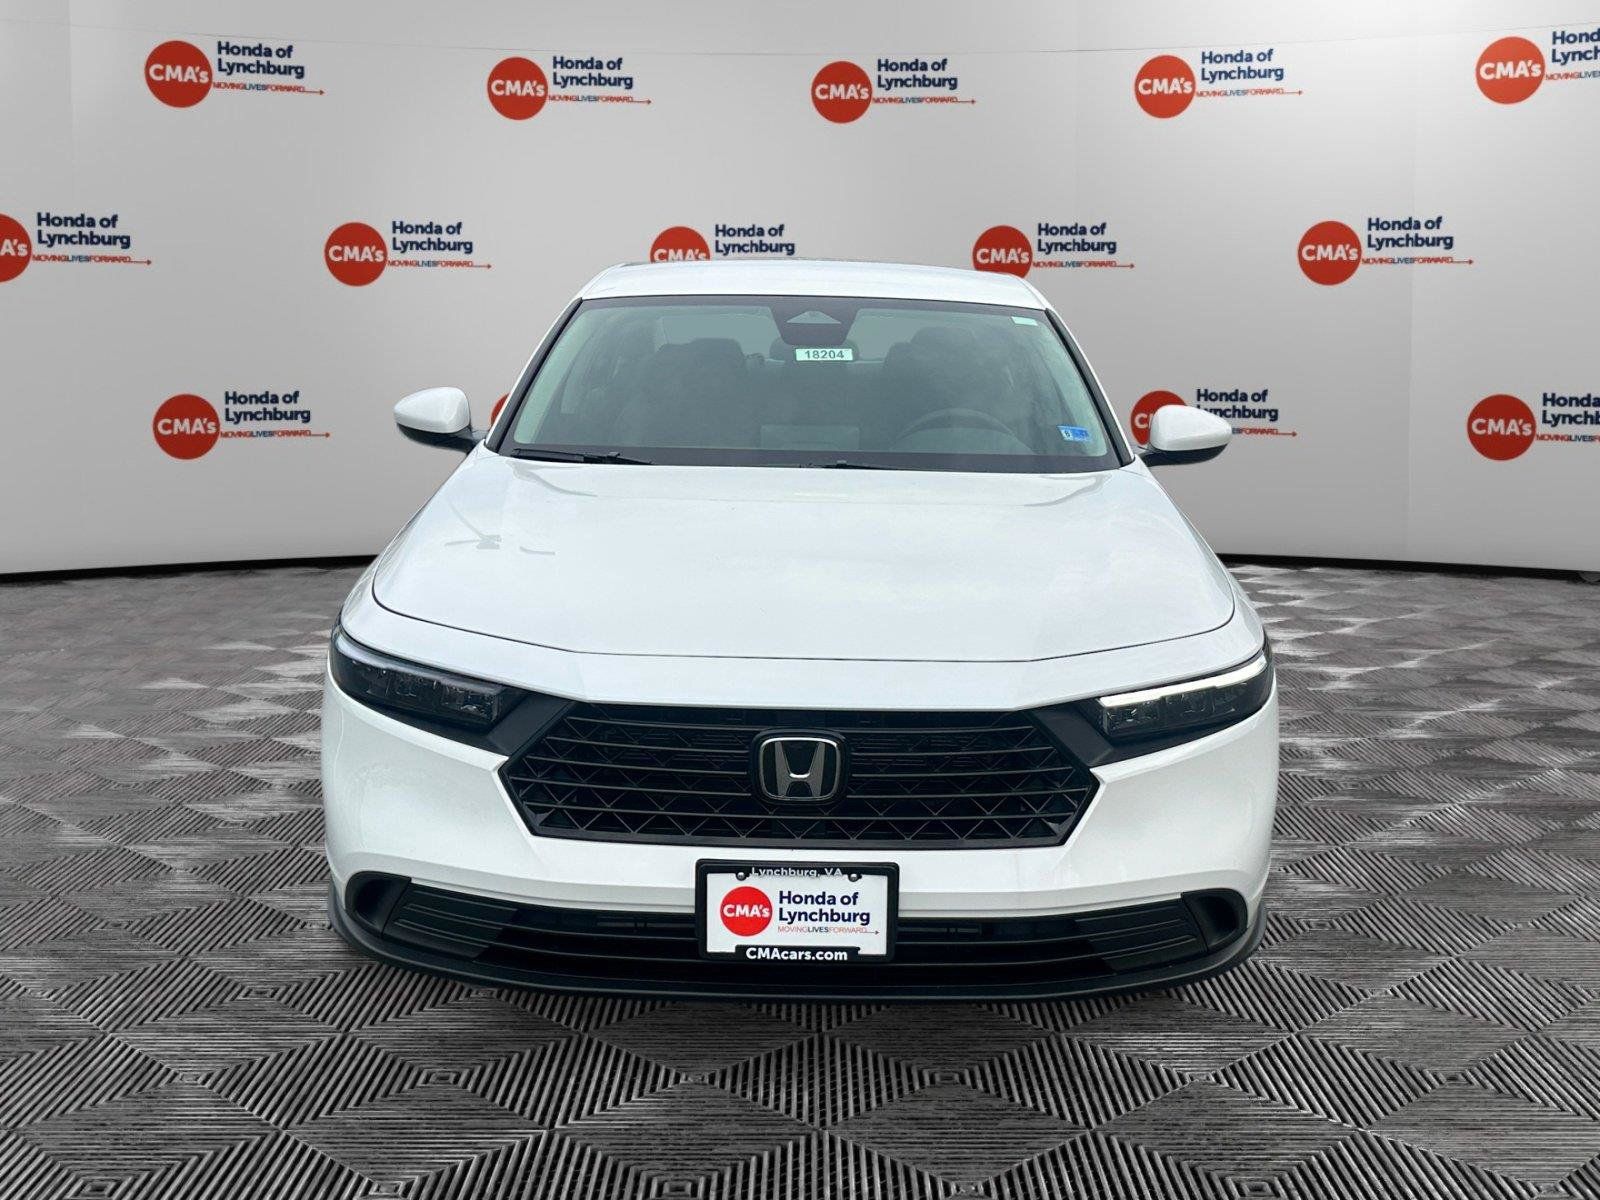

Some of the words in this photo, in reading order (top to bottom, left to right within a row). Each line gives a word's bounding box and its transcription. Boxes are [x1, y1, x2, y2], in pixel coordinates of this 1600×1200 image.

[217, 41, 272, 58] Honda
[275, 44, 294, 58] of
[1201, 51, 1253, 66] Honda
[1256, 49, 1274, 64] of
[217, 57, 305, 79] Lynchburg
[552, 56, 603, 70] Honda
[604, 57, 623, 71] of
[877, 58, 928, 72] Honda
[930, 59, 948, 72] of
[1479, 60, 1542, 81] CMA's
[148, 63, 210, 83] CMA's
[552, 72, 634, 89] Lynchburg
[1201, 67, 1285, 84] Lynchburg
[491, 80, 546, 98] CMA's
[815, 83, 869, 100] CMA's
[877, 75, 958, 91] Lynchburg
[1138, 79, 1193, 96] CMA's
[37, 212, 94, 228] Honda
[99, 214, 118, 229] of
[391, 221, 443, 235] Honda
[445, 221, 463, 235] of
[1367, 217, 1420, 232] Honda
[1423, 217, 1443, 231] of
[714, 223, 766, 237] Honda
[767, 223, 785, 237] of
[1037, 223, 1087, 237] Honda
[1089, 222, 1107, 236] of
[37, 229, 131, 249] Lynchburg
[391, 238, 474, 254] Lynchburg
[1037, 239, 1117, 255] Lynchburg
[1367, 233, 1454, 250] Lynchburg
[328, 245, 385, 262] CMA's
[714, 240, 796, 256] Lynchburg
[976, 248, 1029, 264] CMA's
[1302, 245, 1358, 262] CMA's
[804, 350, 845, 359] 18204
[224, 390, 280, 405] Honda
[281, 390, 300, 405] of
[1196, 388, 1249, 402] Honda
[1250, 388, 1269, 402] of
[224, 407, 311, 425] Lynchburg
[157, 418, 217, 435] CMA's
[1471, 418, 1532, 436] CMA's
[824, 868, 843, 877] VA
[778, 890, 836, 905] Honda
[840, 890, 859, 905] of
[722, 903, 771, 918] CMA's
[778, 907, 871, 925] Lynchburg
[746, 948, 848, 961] CMAcars.com
